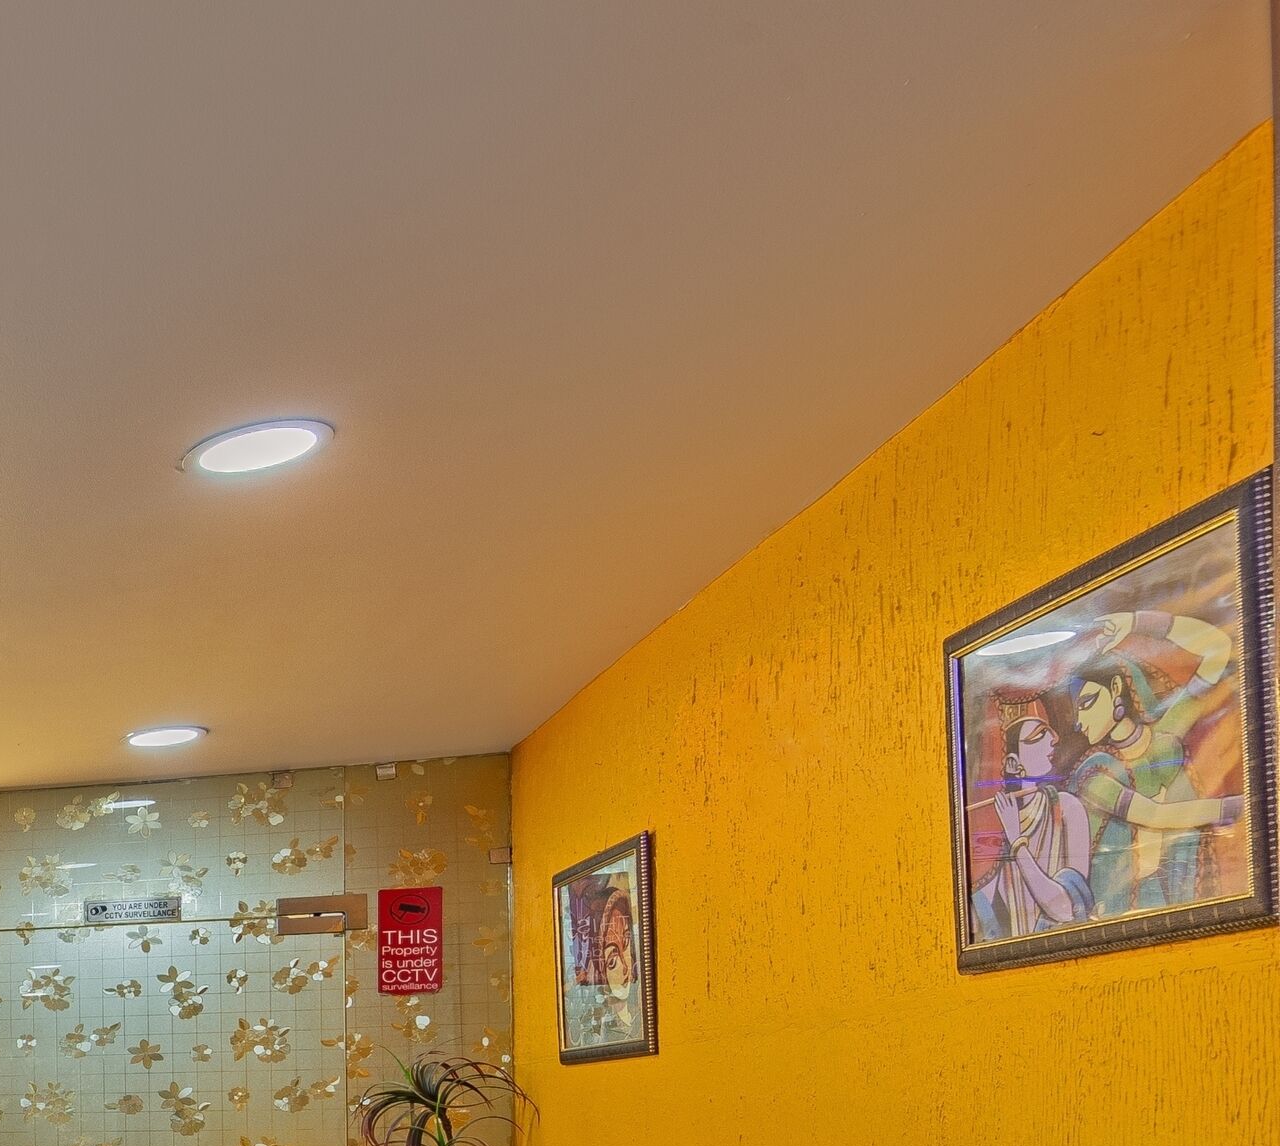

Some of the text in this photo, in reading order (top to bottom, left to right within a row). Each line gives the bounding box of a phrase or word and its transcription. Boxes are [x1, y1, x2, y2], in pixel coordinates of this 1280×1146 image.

[112, 903, 126, 911] YOU
[144, 901, 168, 909] UNDER
[124, 909, 176, 919] SURVEILLANCE
[382, 928, 438, 945] THIS
[382, 945, 438, 957] Property
[382, 957, 438, 968] is under
[382, 968, 438, 983] CCTV
[382, 982, 438, 991] surveillance
